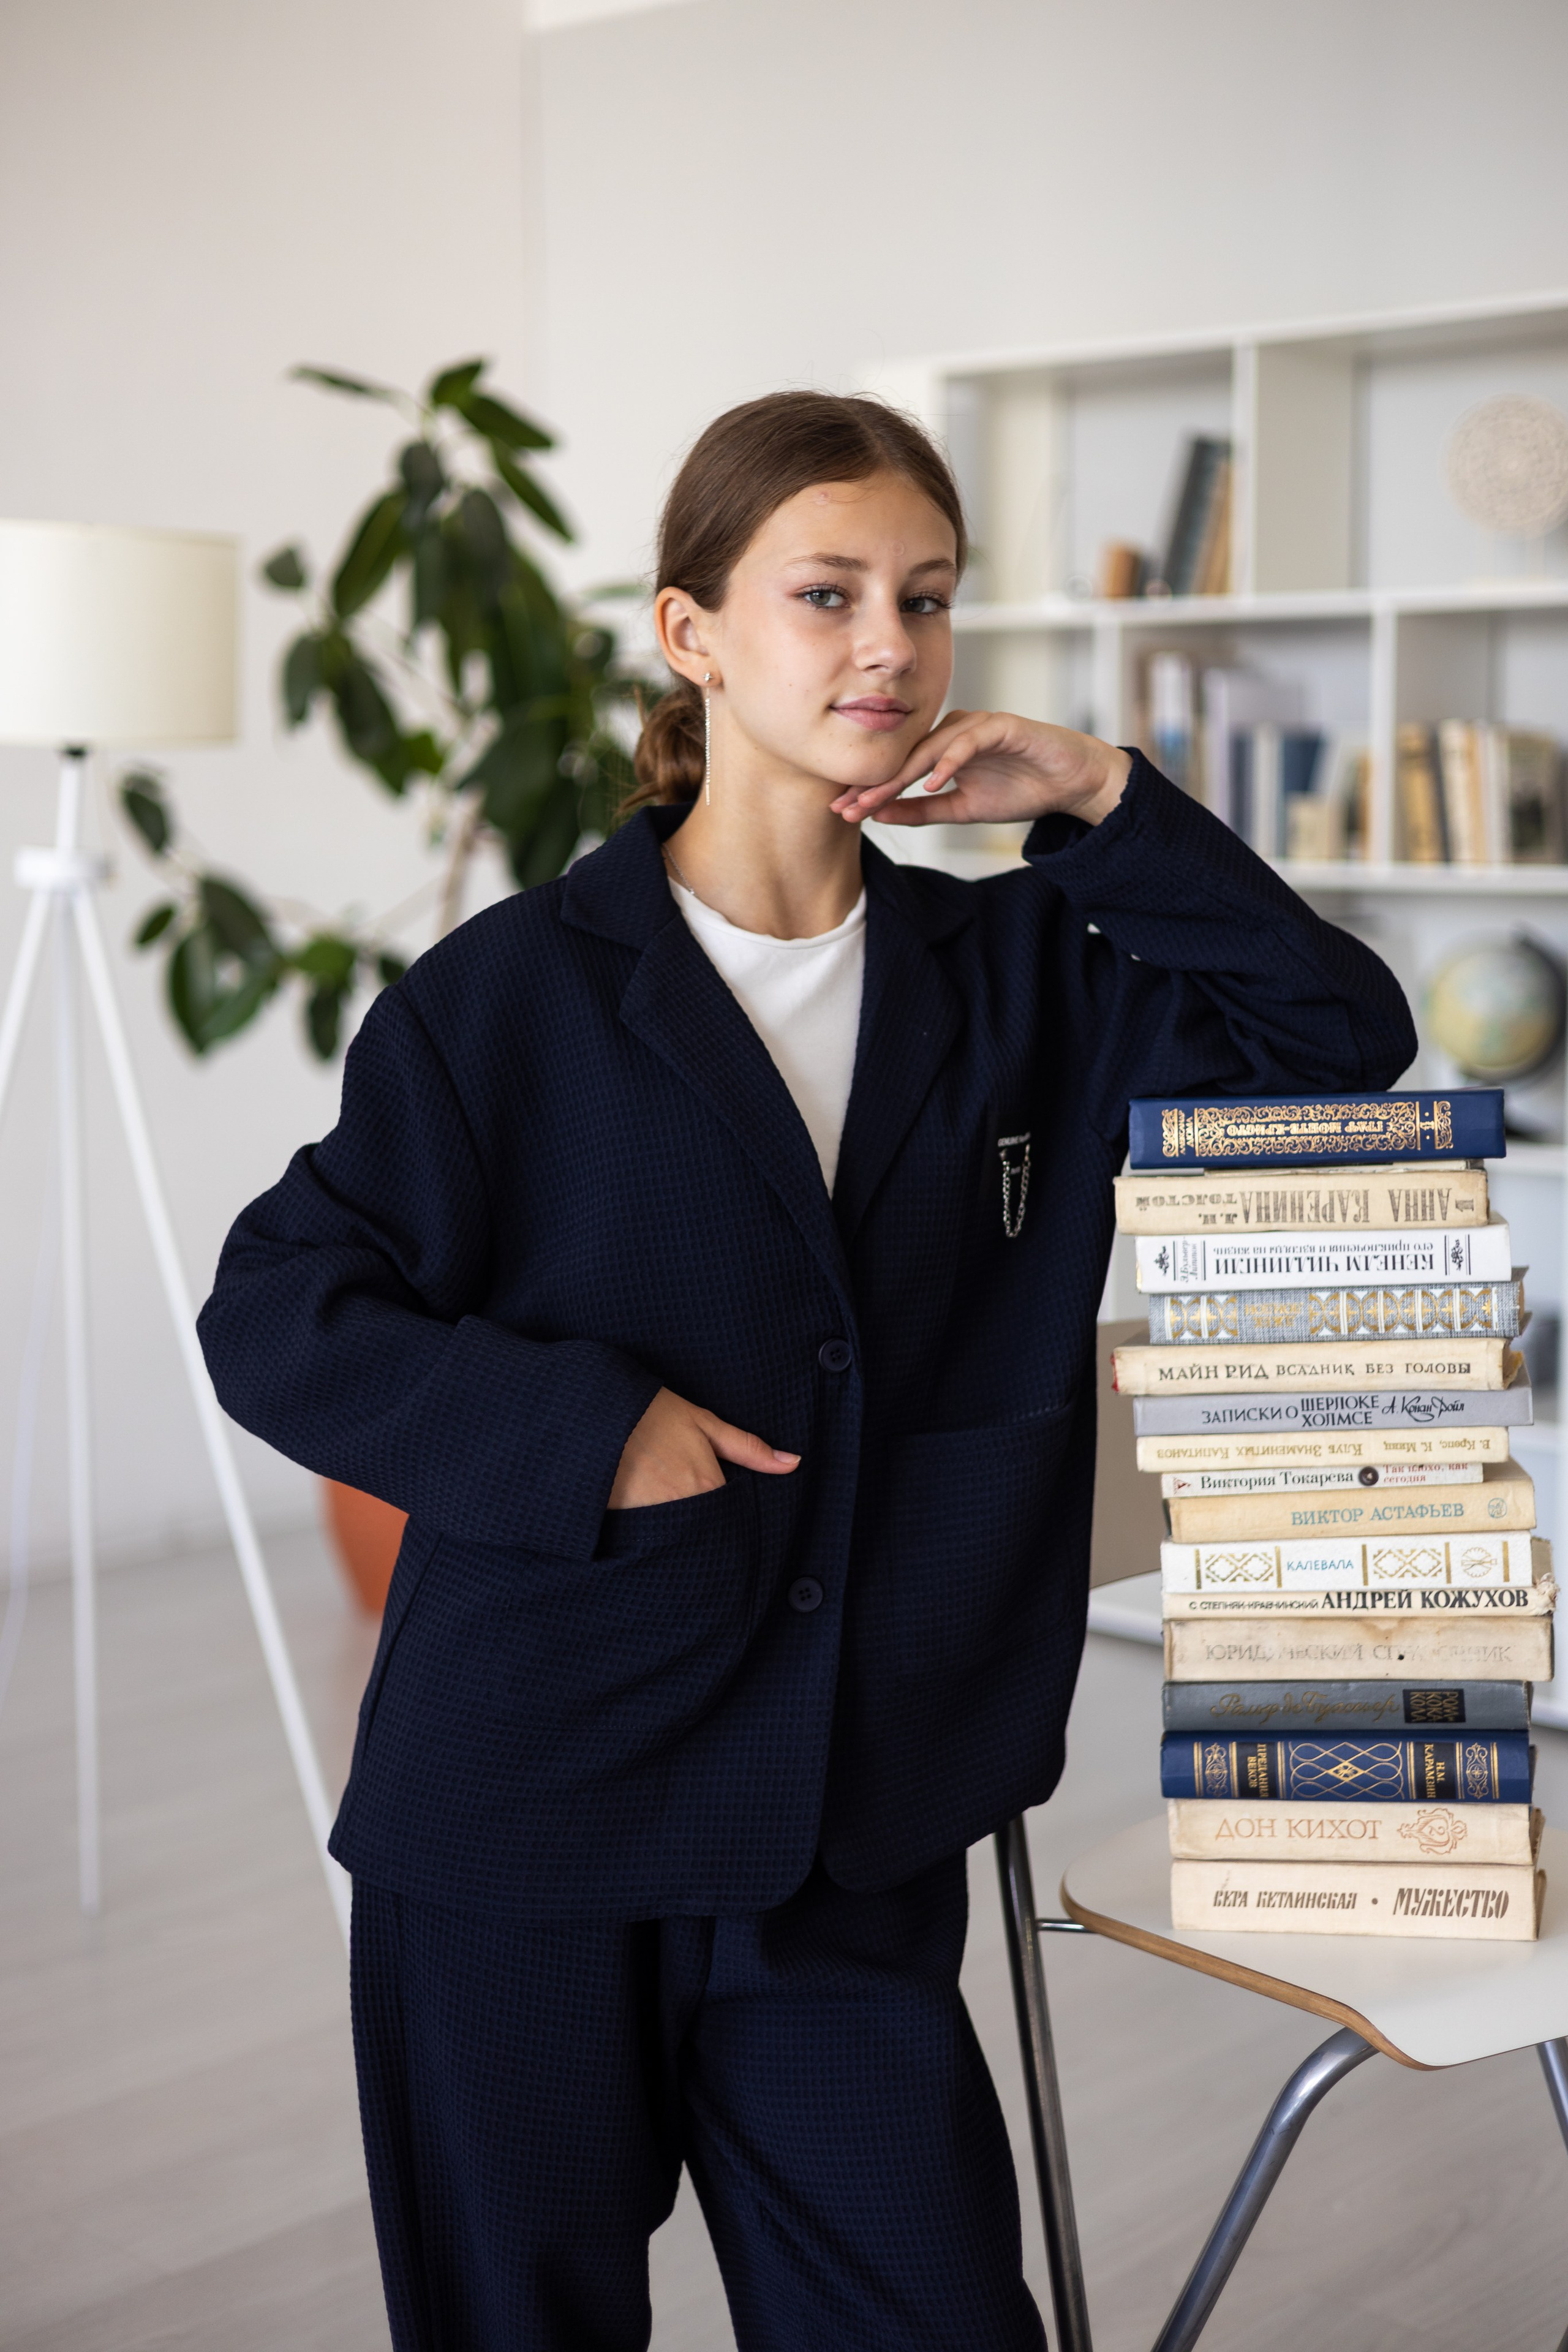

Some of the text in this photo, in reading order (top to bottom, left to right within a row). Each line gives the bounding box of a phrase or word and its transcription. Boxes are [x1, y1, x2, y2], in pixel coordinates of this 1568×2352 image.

[1226, 1120, 1384, 1136] ГРАФ МОНТЕ-КРИСТО
[1135, 1193, 1238, 1212] ТОЛСТОЙ
[1239, 1188, 1452, 1224] АННА КАРЕНИНА
[1455, 1199, 1474, 1213] 1
[1213, 1239, 1434, 1255] его приключения и взгляды на жизнь
[1215, 1253, 1434, 1275] КЕНЕЛМ ЧИЛЛИНГЛИ
[1158, 1362, 1471, 1381] МАЙН РИД ВСАДНИК БЕЗ ГОЛОВЫ
[1301, 1395, 1379, 1412] ШЕРЛОКЕ
[1401, 1395, 1434, 1422] Конан
[1431, 1395, 1465, 1419] Дойл
[1201, 1405, 1298, 1425] ЗАПИСКИ О
[1301, 1410, 1373, 1428] ХОЛМСЕ
[1384, 1440, 1417, 1452] Минц
[1420, 1441, 1433, 1452] К.
[1480, 1439, 1491, 1449] В.
[1382, 1463, 1404, 1474] Так
[1200, 1475, 1276, 1490] Виктория
[1279, 1471, 1353, 1487] Токарева
[1383, 1475, 1427, 1485] сегодня
[1291, 1502, 1465, 1526] ВИКТОР АСТАФЬЕВ
[1286, 1559, 1354, 1572] КАЛЕВАЛА
[1321, 1589, 1529, 1611] АНДРЕЙ КОЖУХОВ
[1409, 1691, 1427, 1722] КОЛА
[1426, 1691, 1443, 1722] КОКА
[1247, 1756, 1258, 1789] ВЕКОВ
[1257, 1743, 1269, 1798] ПРЕДАНИЯ
[1424, 1744, 1436, 1798] КАРАМЗИН
[1215, 1818, 1382, 1841] ДОН КИХОТ
[1213, 1887, 1510, 1919] ВЕРА КЕТЛИНСКАЯ МУЖЕСТВО
